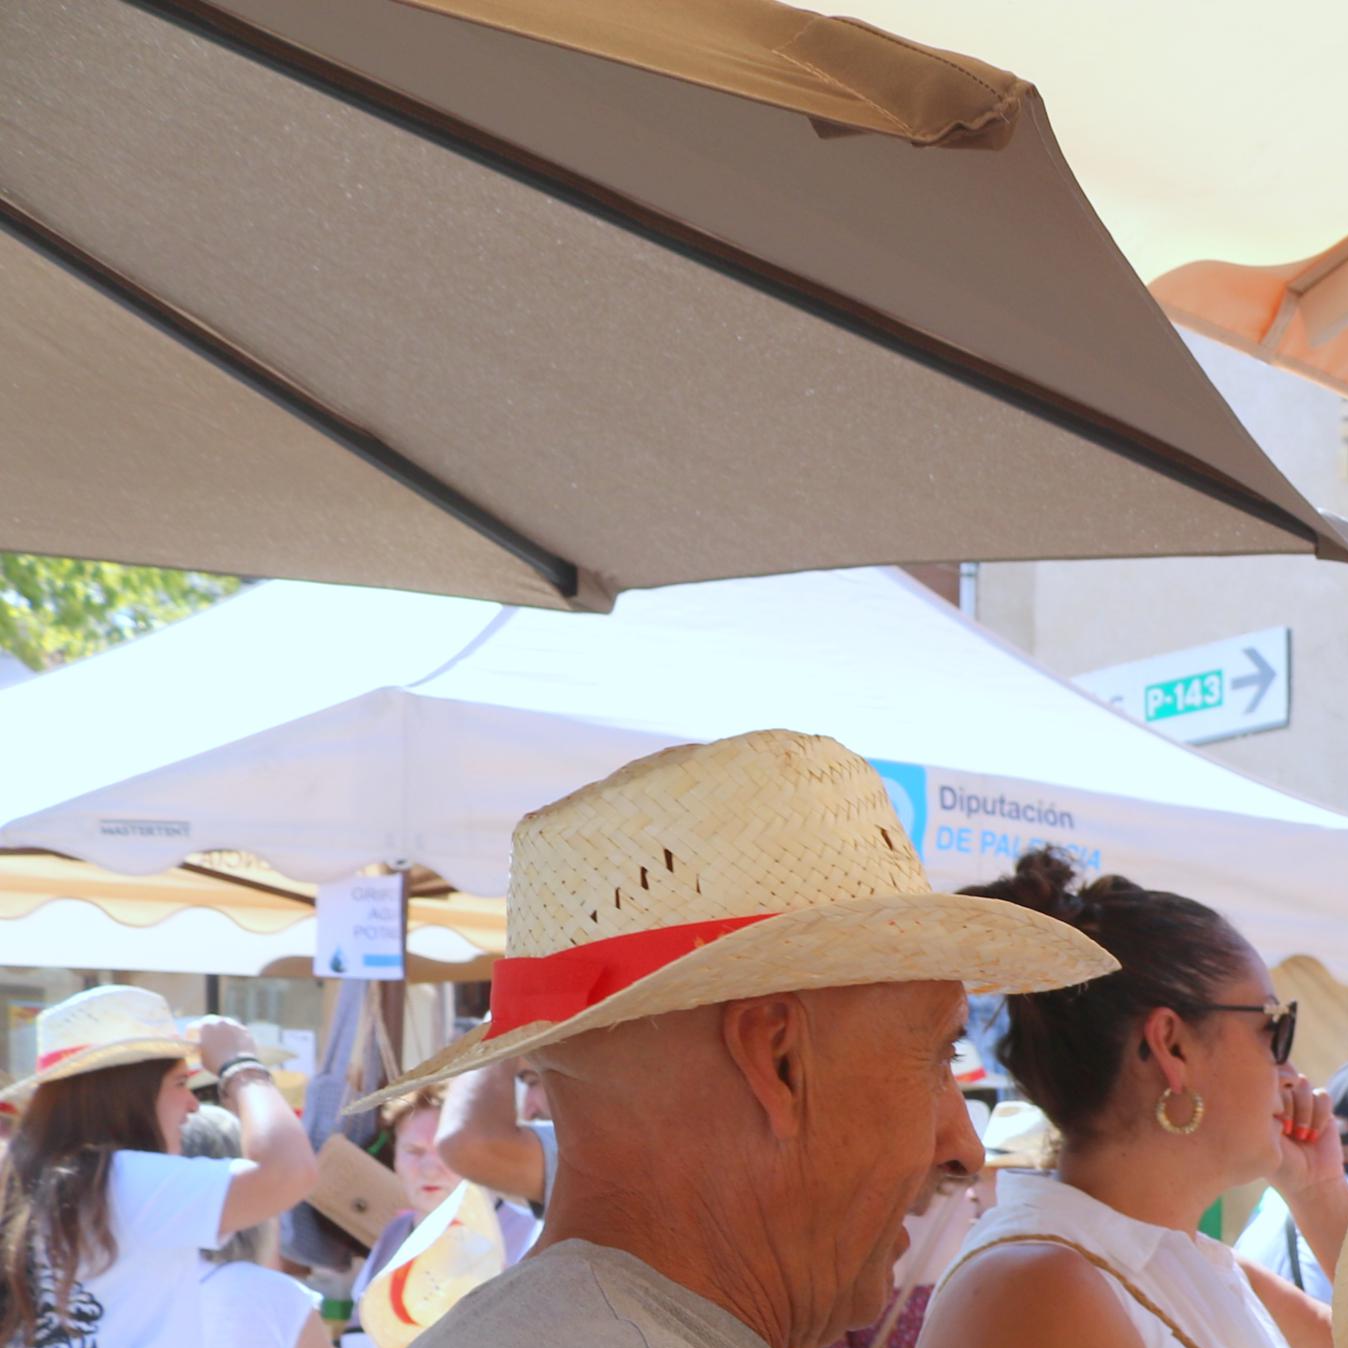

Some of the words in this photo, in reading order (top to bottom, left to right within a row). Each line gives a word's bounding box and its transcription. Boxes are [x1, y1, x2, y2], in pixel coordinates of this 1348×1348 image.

[1147, 673, 1221, 717] P-143
[939, 786, 1074, 829] Diputación
[936, 826, 973, 853] DE
[983, 830, 1101, 869] PALCIA
